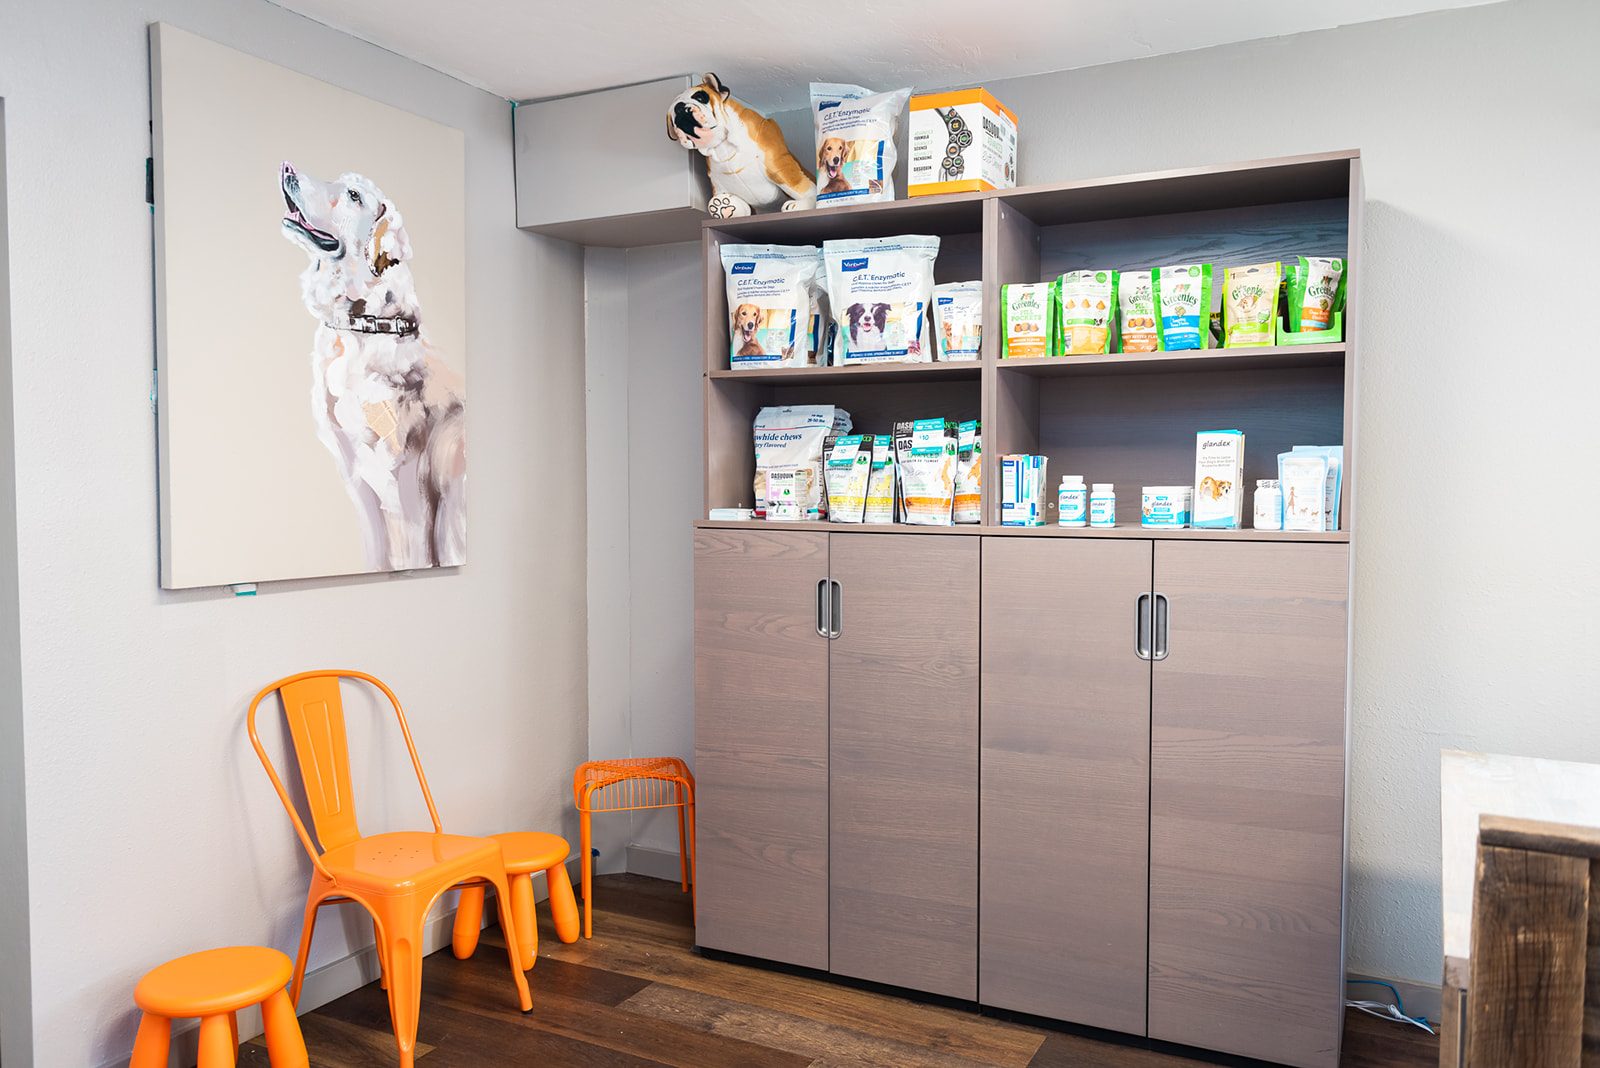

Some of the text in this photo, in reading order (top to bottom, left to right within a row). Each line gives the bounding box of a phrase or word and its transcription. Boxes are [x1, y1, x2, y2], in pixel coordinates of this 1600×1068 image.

[753, 277, 785, 286] Enzymatic
[870, 271, 906, 282] Enzymatic
[1162, 293, 1199, 306] Greenies
[780, 431, 802, 441] chews
[1202, 440, 1231, 450] glandex
